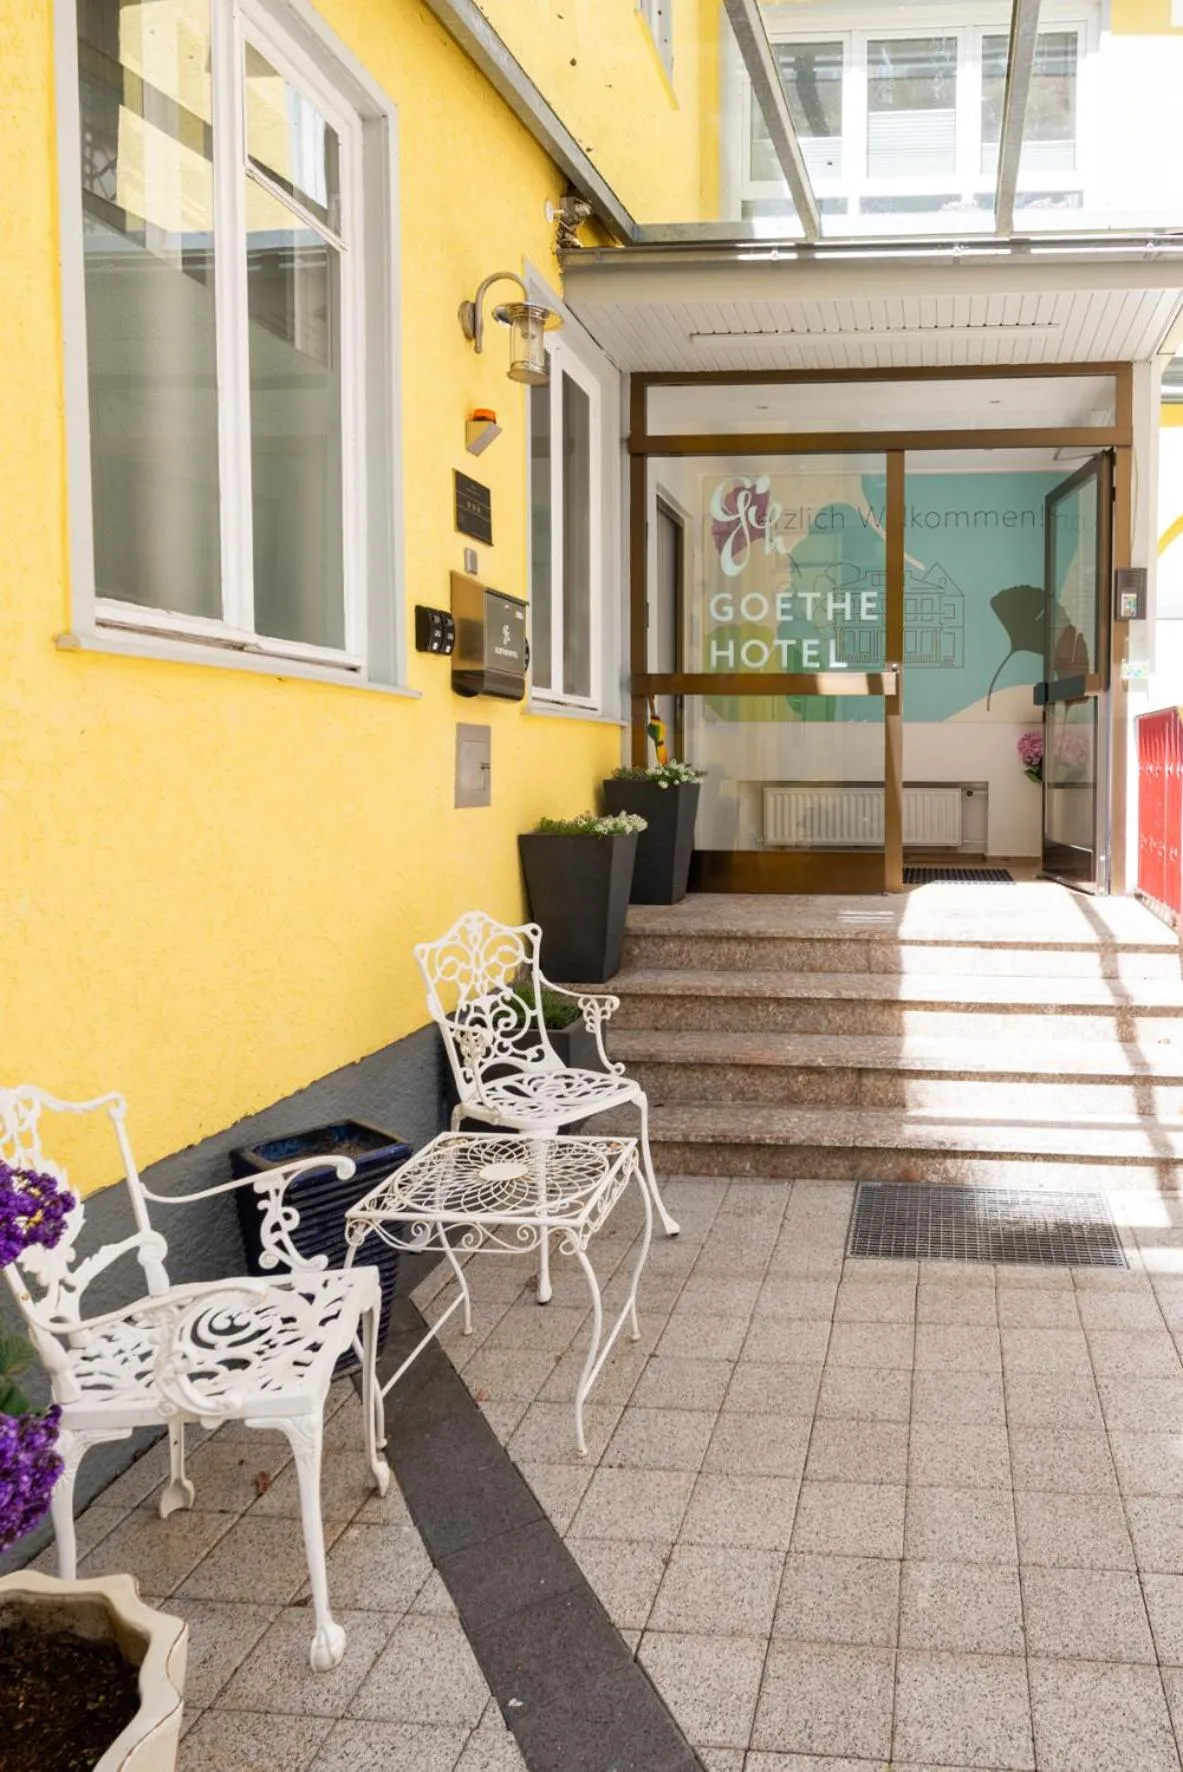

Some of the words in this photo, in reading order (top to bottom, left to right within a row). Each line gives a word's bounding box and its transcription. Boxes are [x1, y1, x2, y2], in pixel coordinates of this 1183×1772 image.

[857, 504, 1044, 530] Wkommen!
[709, 591, 878, 622] GOETHE
[710, 638, 848, 668] HOTEL
